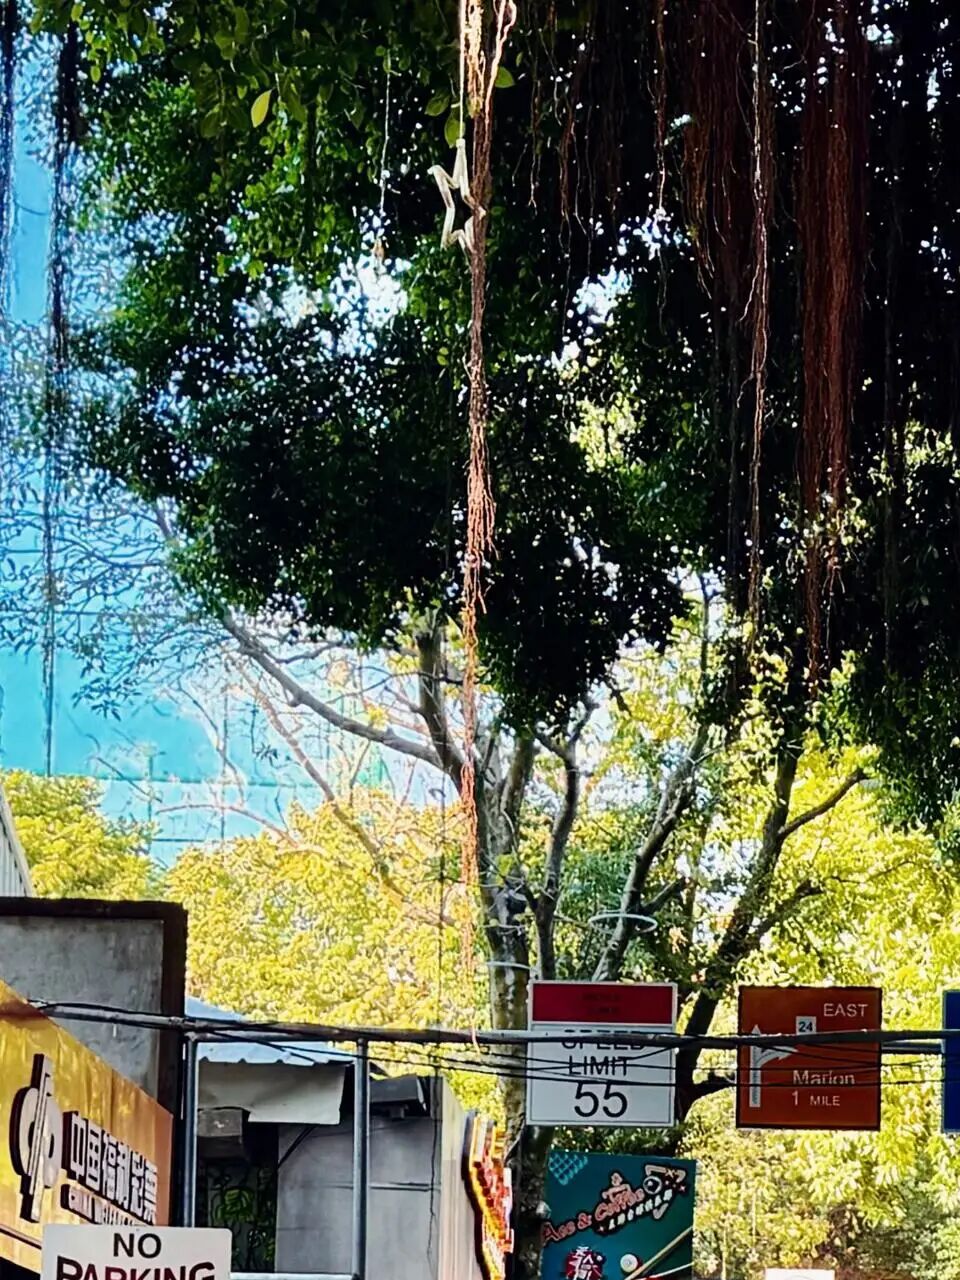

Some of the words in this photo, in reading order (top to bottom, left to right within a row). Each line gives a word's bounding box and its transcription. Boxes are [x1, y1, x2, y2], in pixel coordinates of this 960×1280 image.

[823, 1003, 869, 1017] EAST
[798, 1021, 813, 1033] 24
[569, 1055, 629, 1076] LIMIT
[574, 1081, 628, 1118] 55
[792, 1090, 799, 1106] 1
[810, 1095, 841, 1107] MILE
[66, 1111, 158, 1226] 中国福利彩票
[113, 1232, 162, 1259] NO
